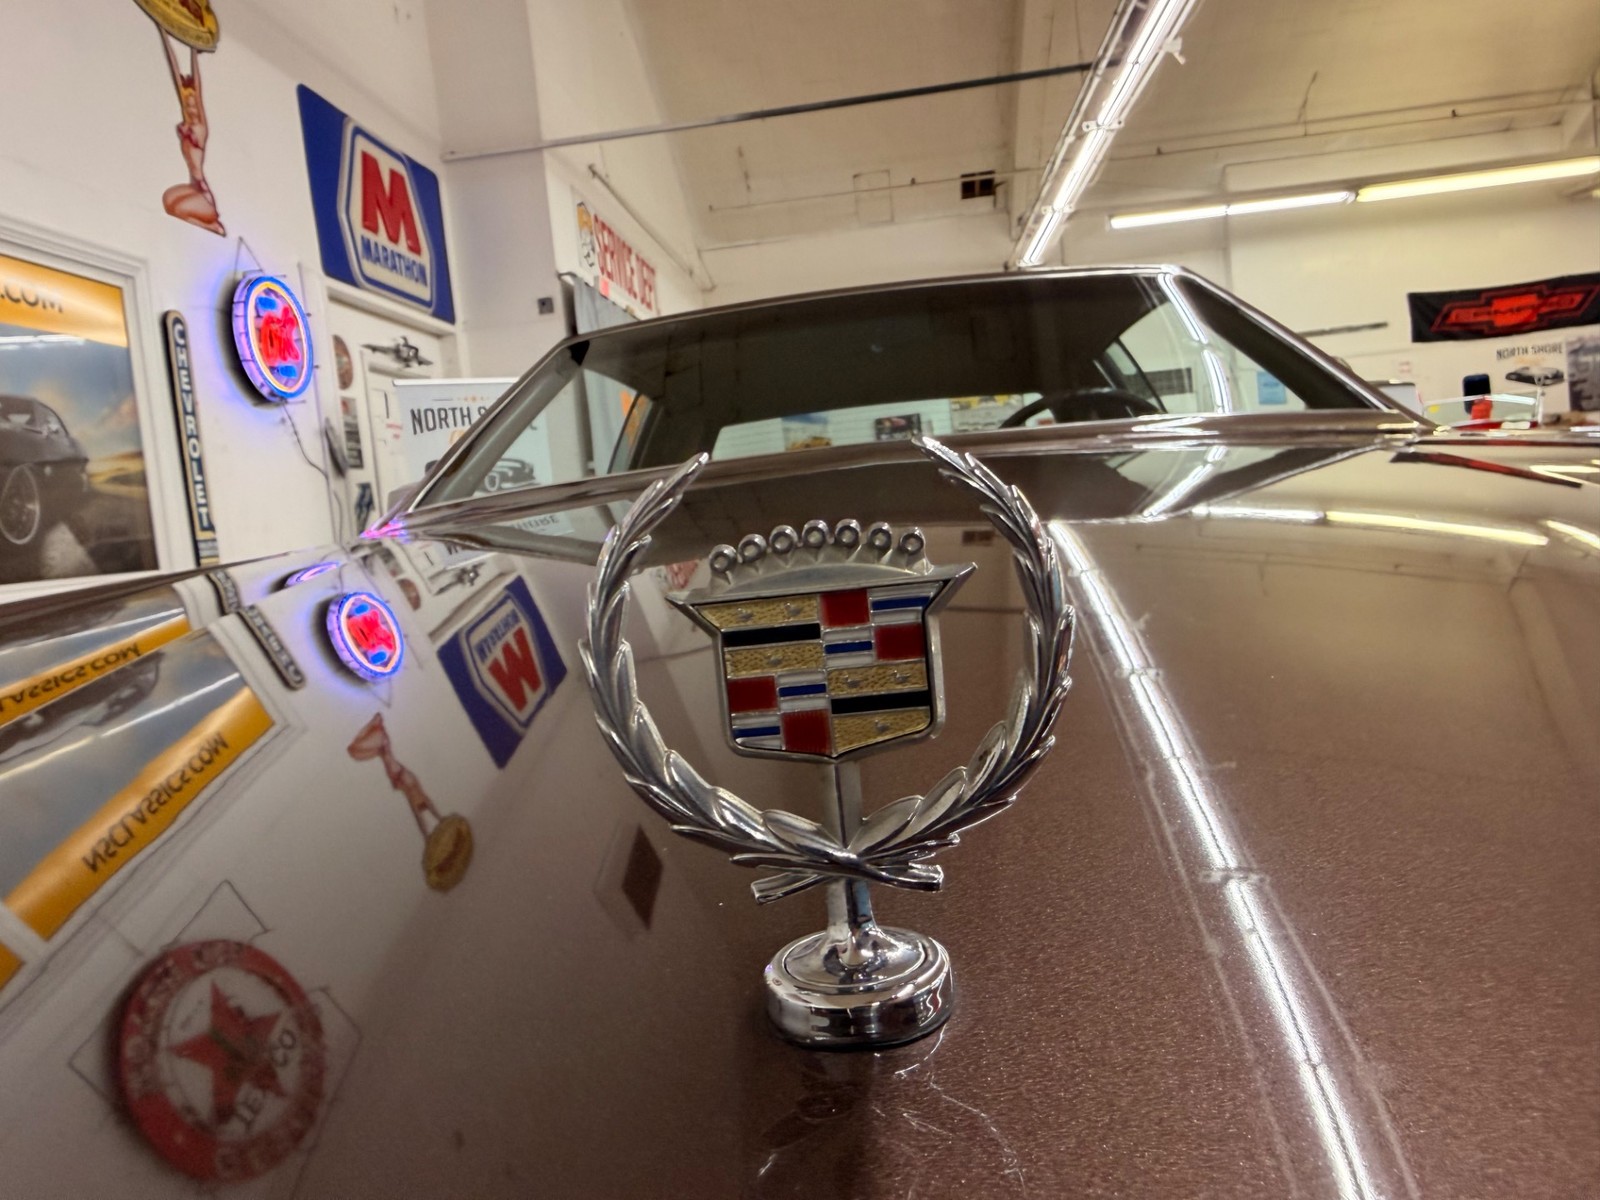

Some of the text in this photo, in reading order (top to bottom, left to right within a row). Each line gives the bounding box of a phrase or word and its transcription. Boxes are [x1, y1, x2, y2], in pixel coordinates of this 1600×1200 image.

[360, 149, 422, 256] M
[360, 234, 428, 287] MARATHON
[173, 322, 211, 530] CHEVROLET
[410, 406, 472, 435] NORTH
